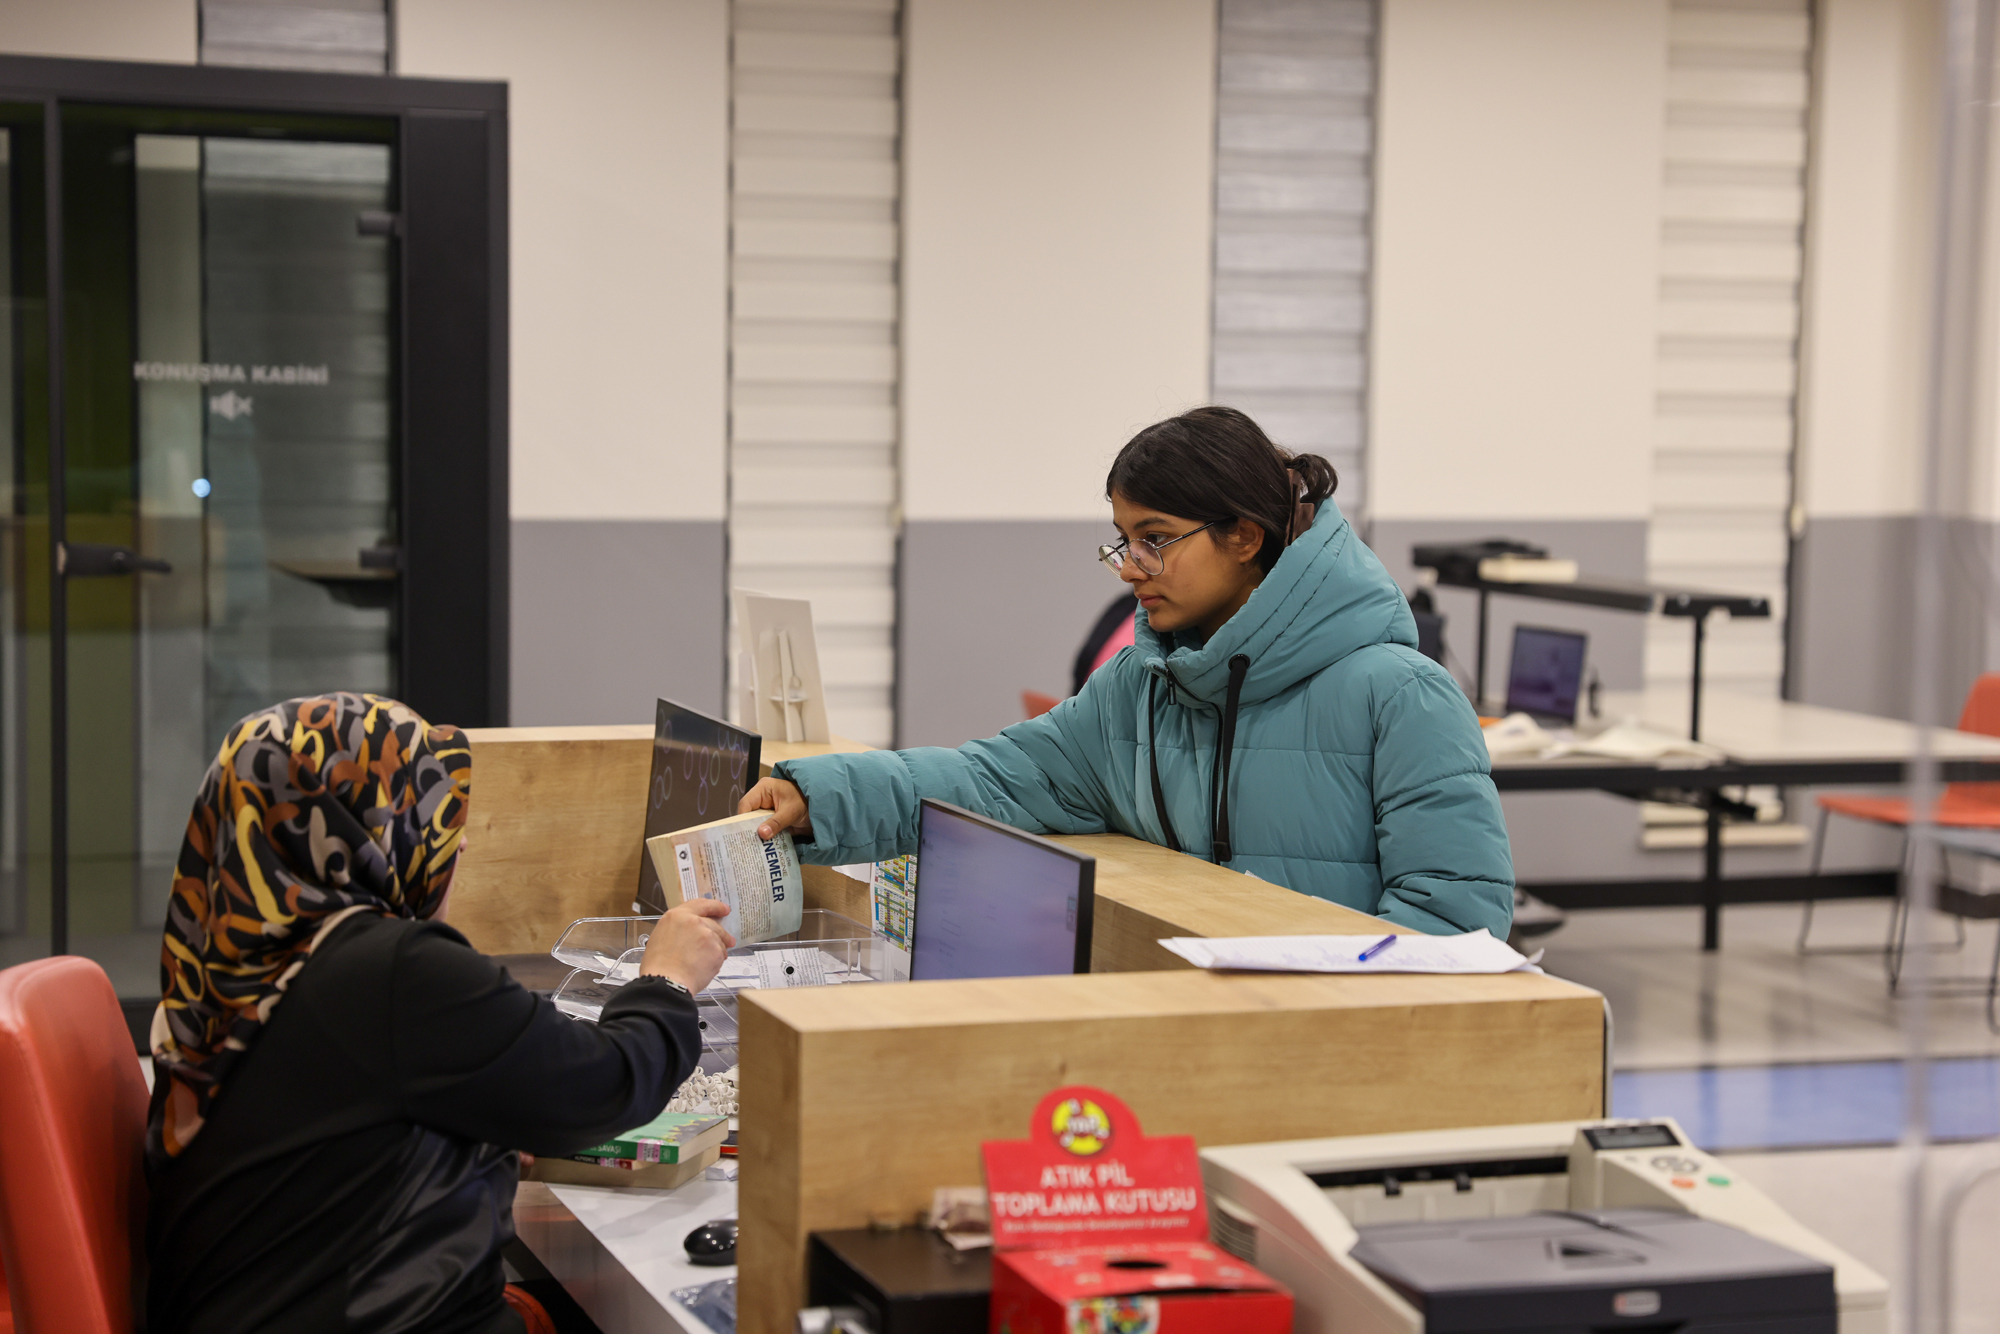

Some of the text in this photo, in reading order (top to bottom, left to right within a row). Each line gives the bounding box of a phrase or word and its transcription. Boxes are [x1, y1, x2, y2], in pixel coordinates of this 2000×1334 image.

[134, 361, 329, 385] KONUŞMA KABİNİ
[1040, 1158, 1136, 1189] ATIK PİL
[992, 1186, 1197, 1217] TOPLAMA KUTUSU
